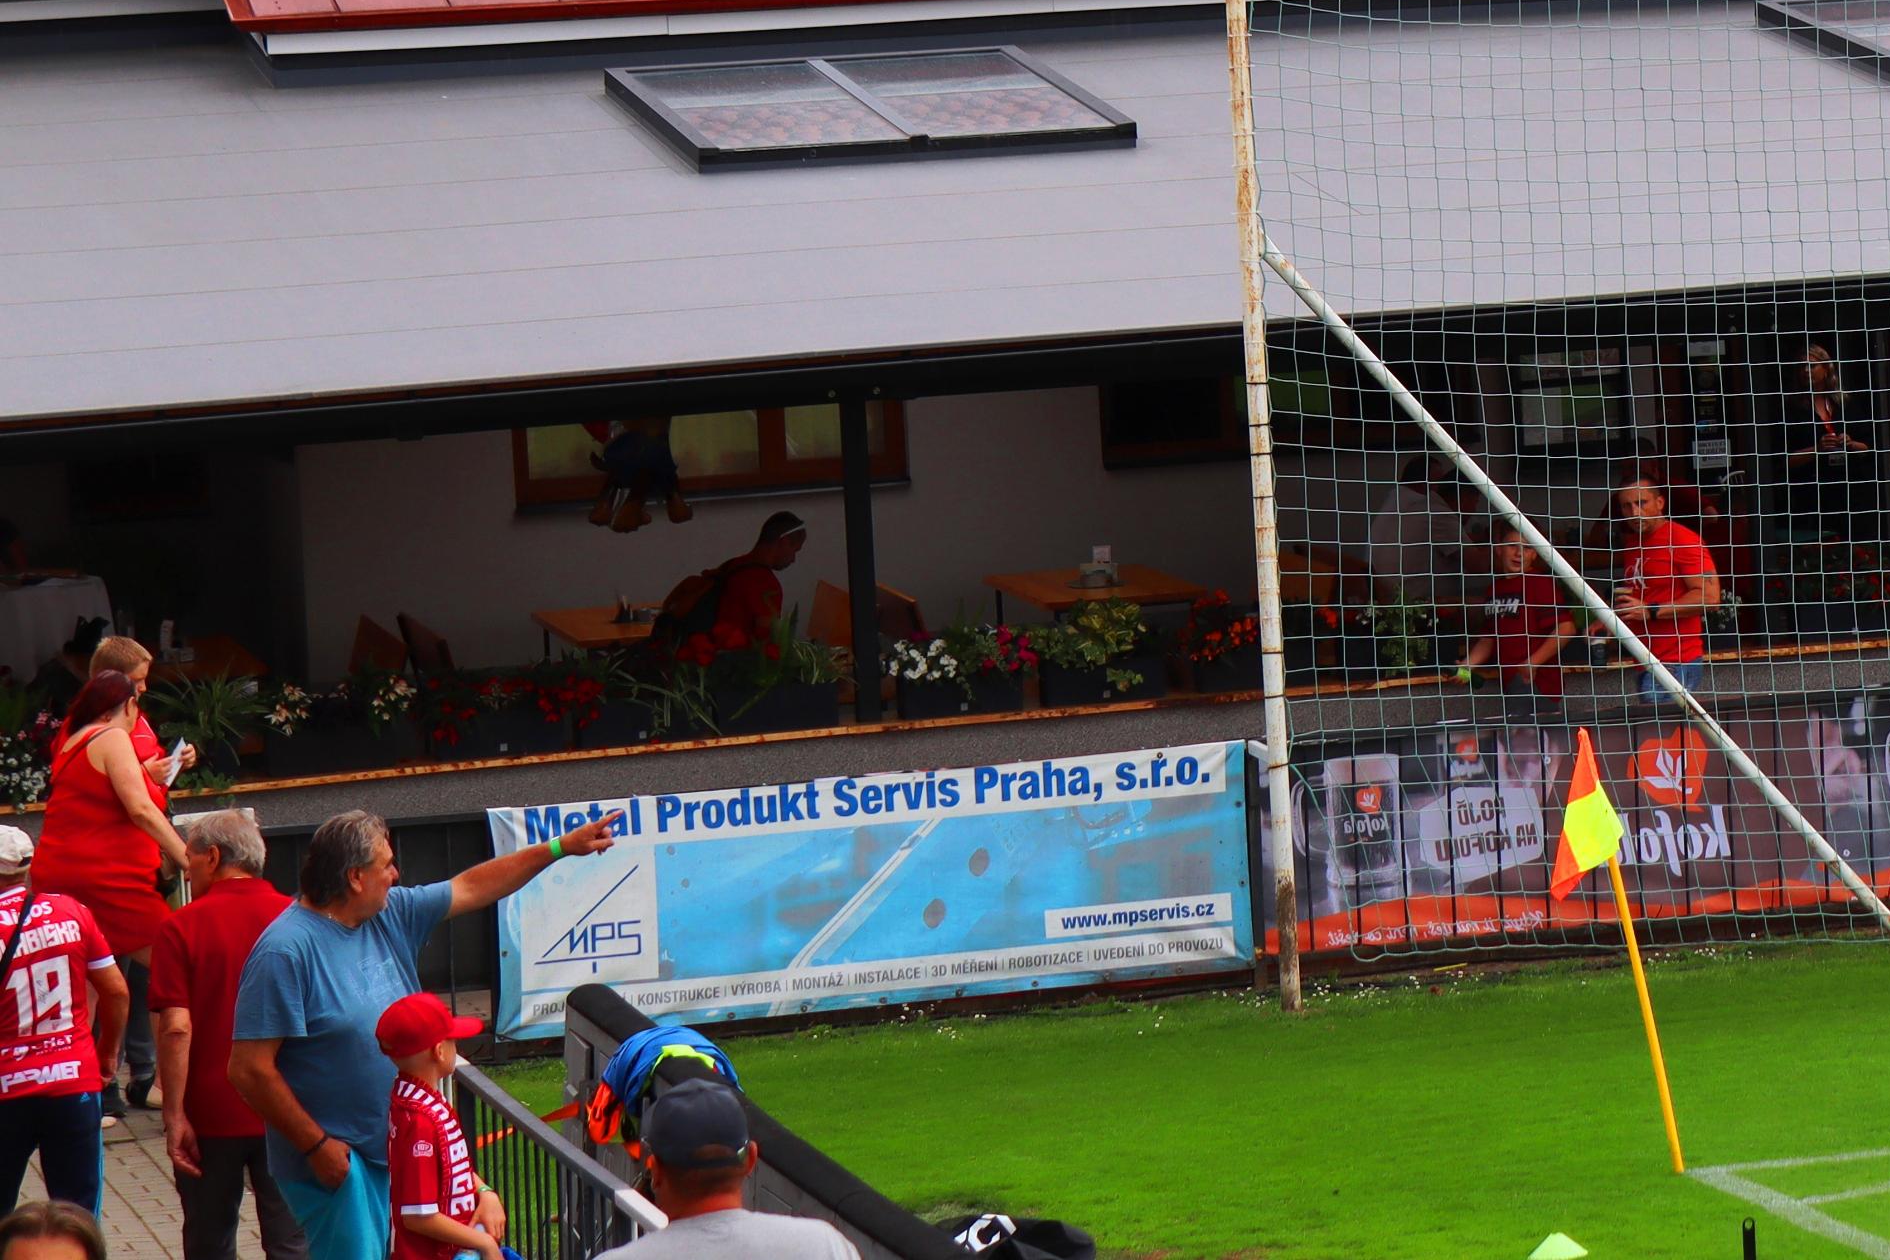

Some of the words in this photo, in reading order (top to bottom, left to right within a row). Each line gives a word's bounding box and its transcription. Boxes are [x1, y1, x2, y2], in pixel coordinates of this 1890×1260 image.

[656, 782, 820, 833] Produkt
[834, 771, 960, 817] Servis
[974, 761, 1103, 805] Praha,
[1061, 902, 1215, 930] www.mpservis.cz
[5, 954, 75, 1038] 19
[637, 986, 720, 1006] KONSTRUKCE
[730, 975, 781, 997] VÝROBA
[792, 968, 845, 991] MONTÁŽ
[854, 966, 921, 987] INSTALACE
[931, 963, 947, 978] 3D
[951, 957, 999, 976] MĚŘENÍ
[1008, 950, 1084, 970] ROBOTIZACE
[1093, 944, 1145, 961] UVEDENÍ
[1148, 942, 1165, 956] DO
[1168, 937, 1223, 954] PROVOZU
[0, 1060, 82, 1093] FARMET
